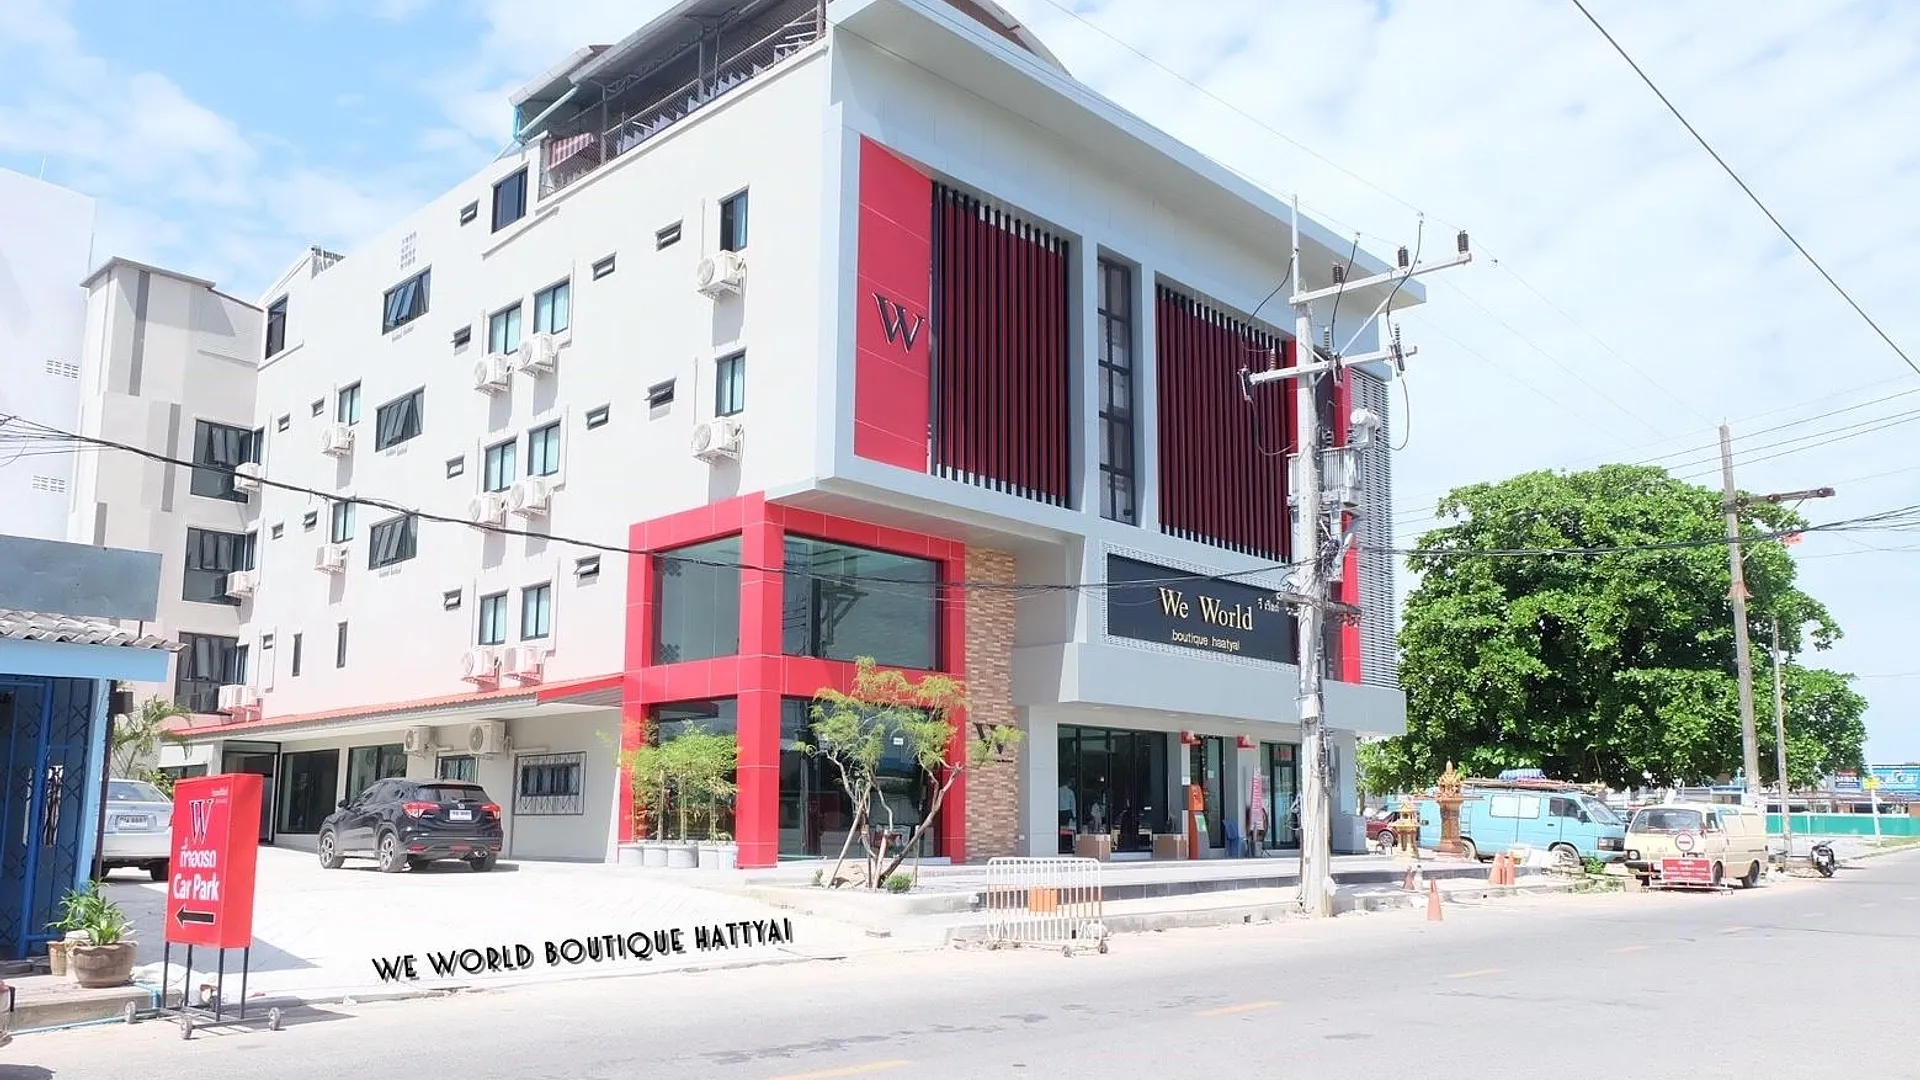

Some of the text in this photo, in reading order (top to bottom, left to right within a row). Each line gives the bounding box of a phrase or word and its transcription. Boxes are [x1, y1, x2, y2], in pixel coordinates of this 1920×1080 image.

[872, 292, 924, 353] W
[1158, 586, 1254, 630] We World
[1172, 629, 1209, 647] boutique
[173, 872, 220, 901] Car Park
